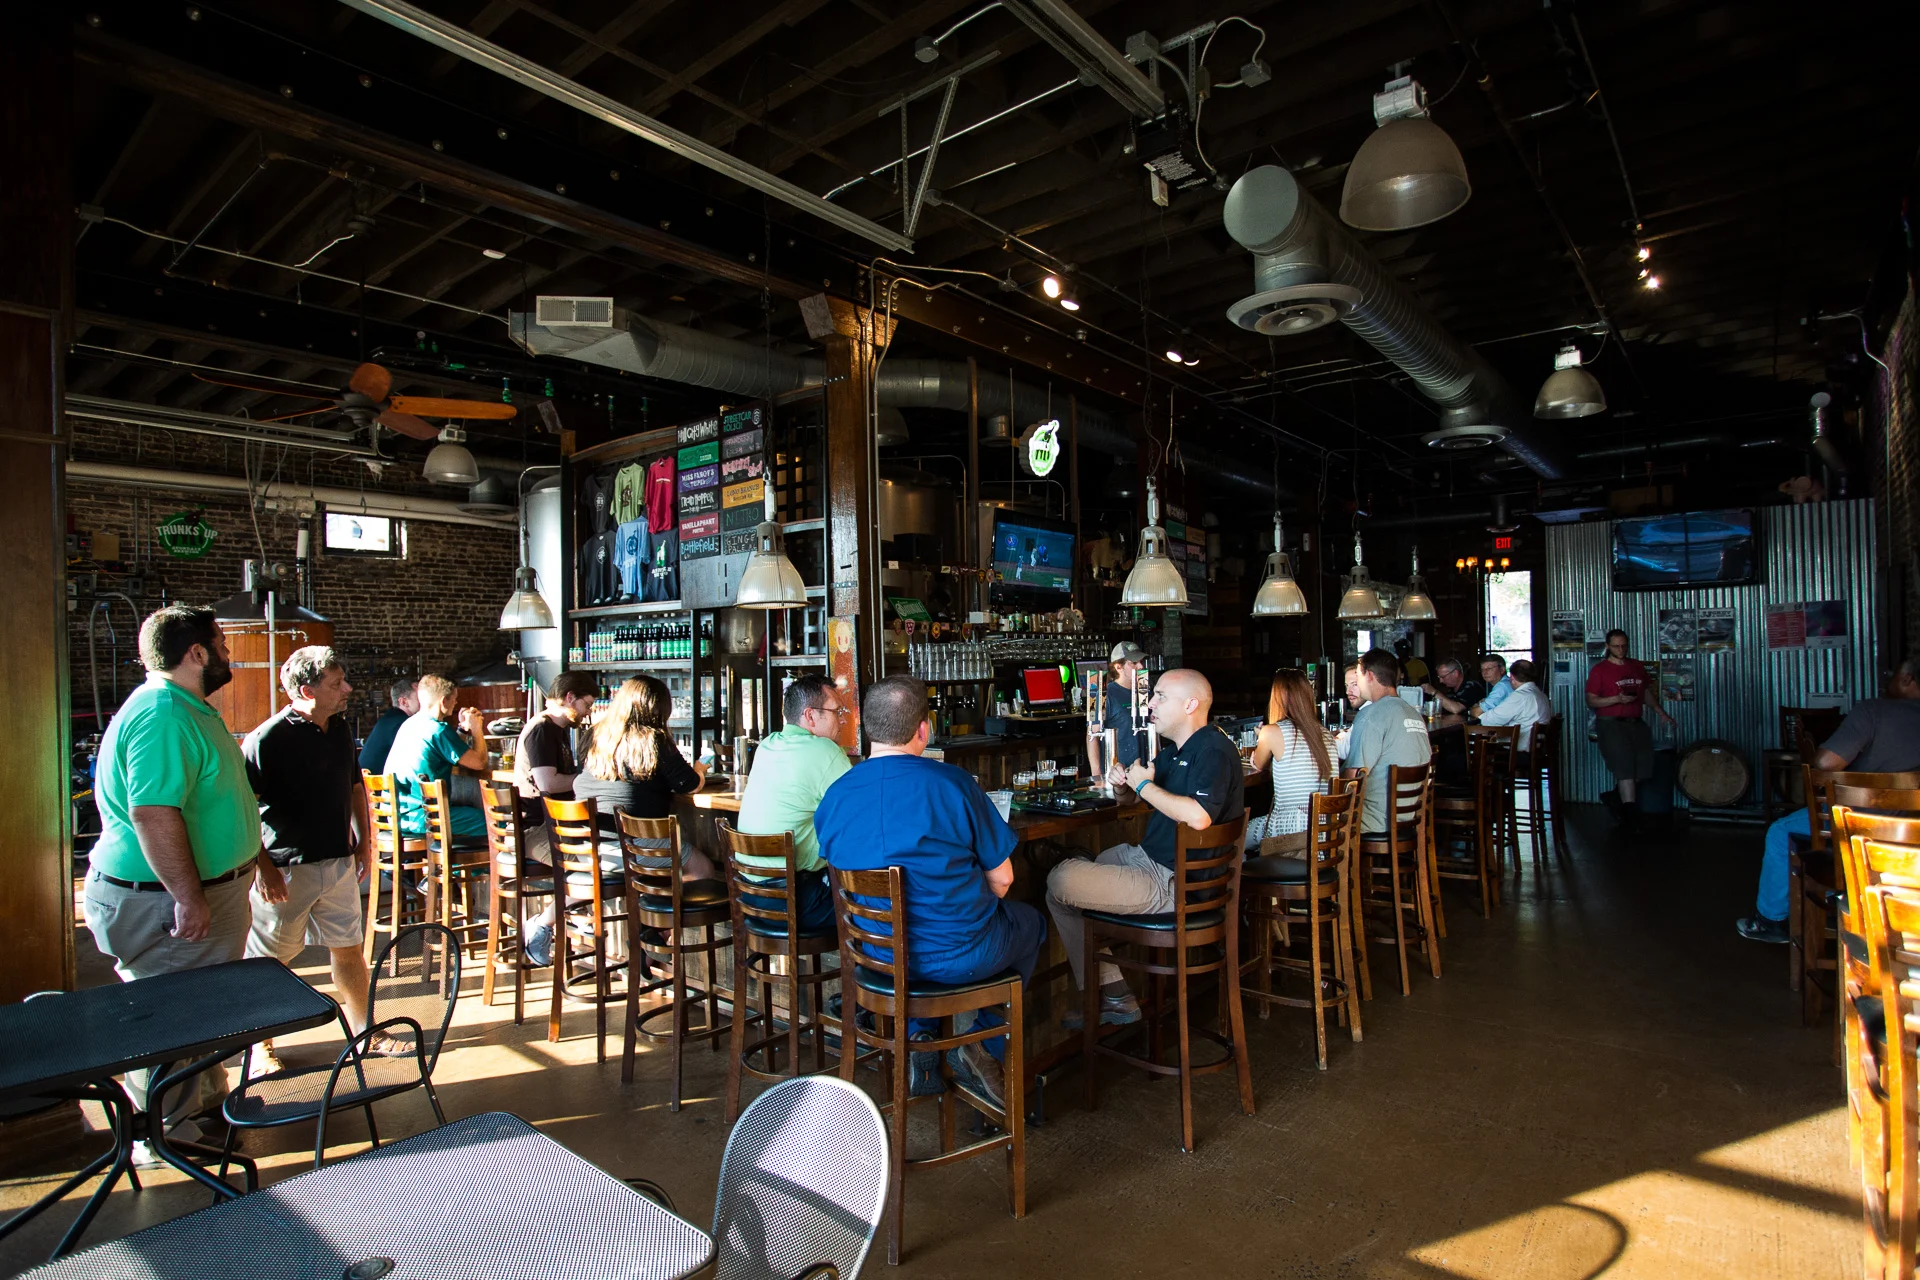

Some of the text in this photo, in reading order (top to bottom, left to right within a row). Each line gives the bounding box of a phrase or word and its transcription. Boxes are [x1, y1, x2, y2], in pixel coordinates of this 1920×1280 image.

[723, 411, 752, 425] STREETCAR
[681, 472, 694, 482] MISS
[682, 518, 715, 530] VANILLAPHANT
[726, 507, 759, 527] NITRO
[156, 524, 218, 540] TRUNKS UP
[680, 536, 715, 555] Battlefield
[726, 533, 757, 547] GINGE
[1495, 537, 1512, 549] EXIT
